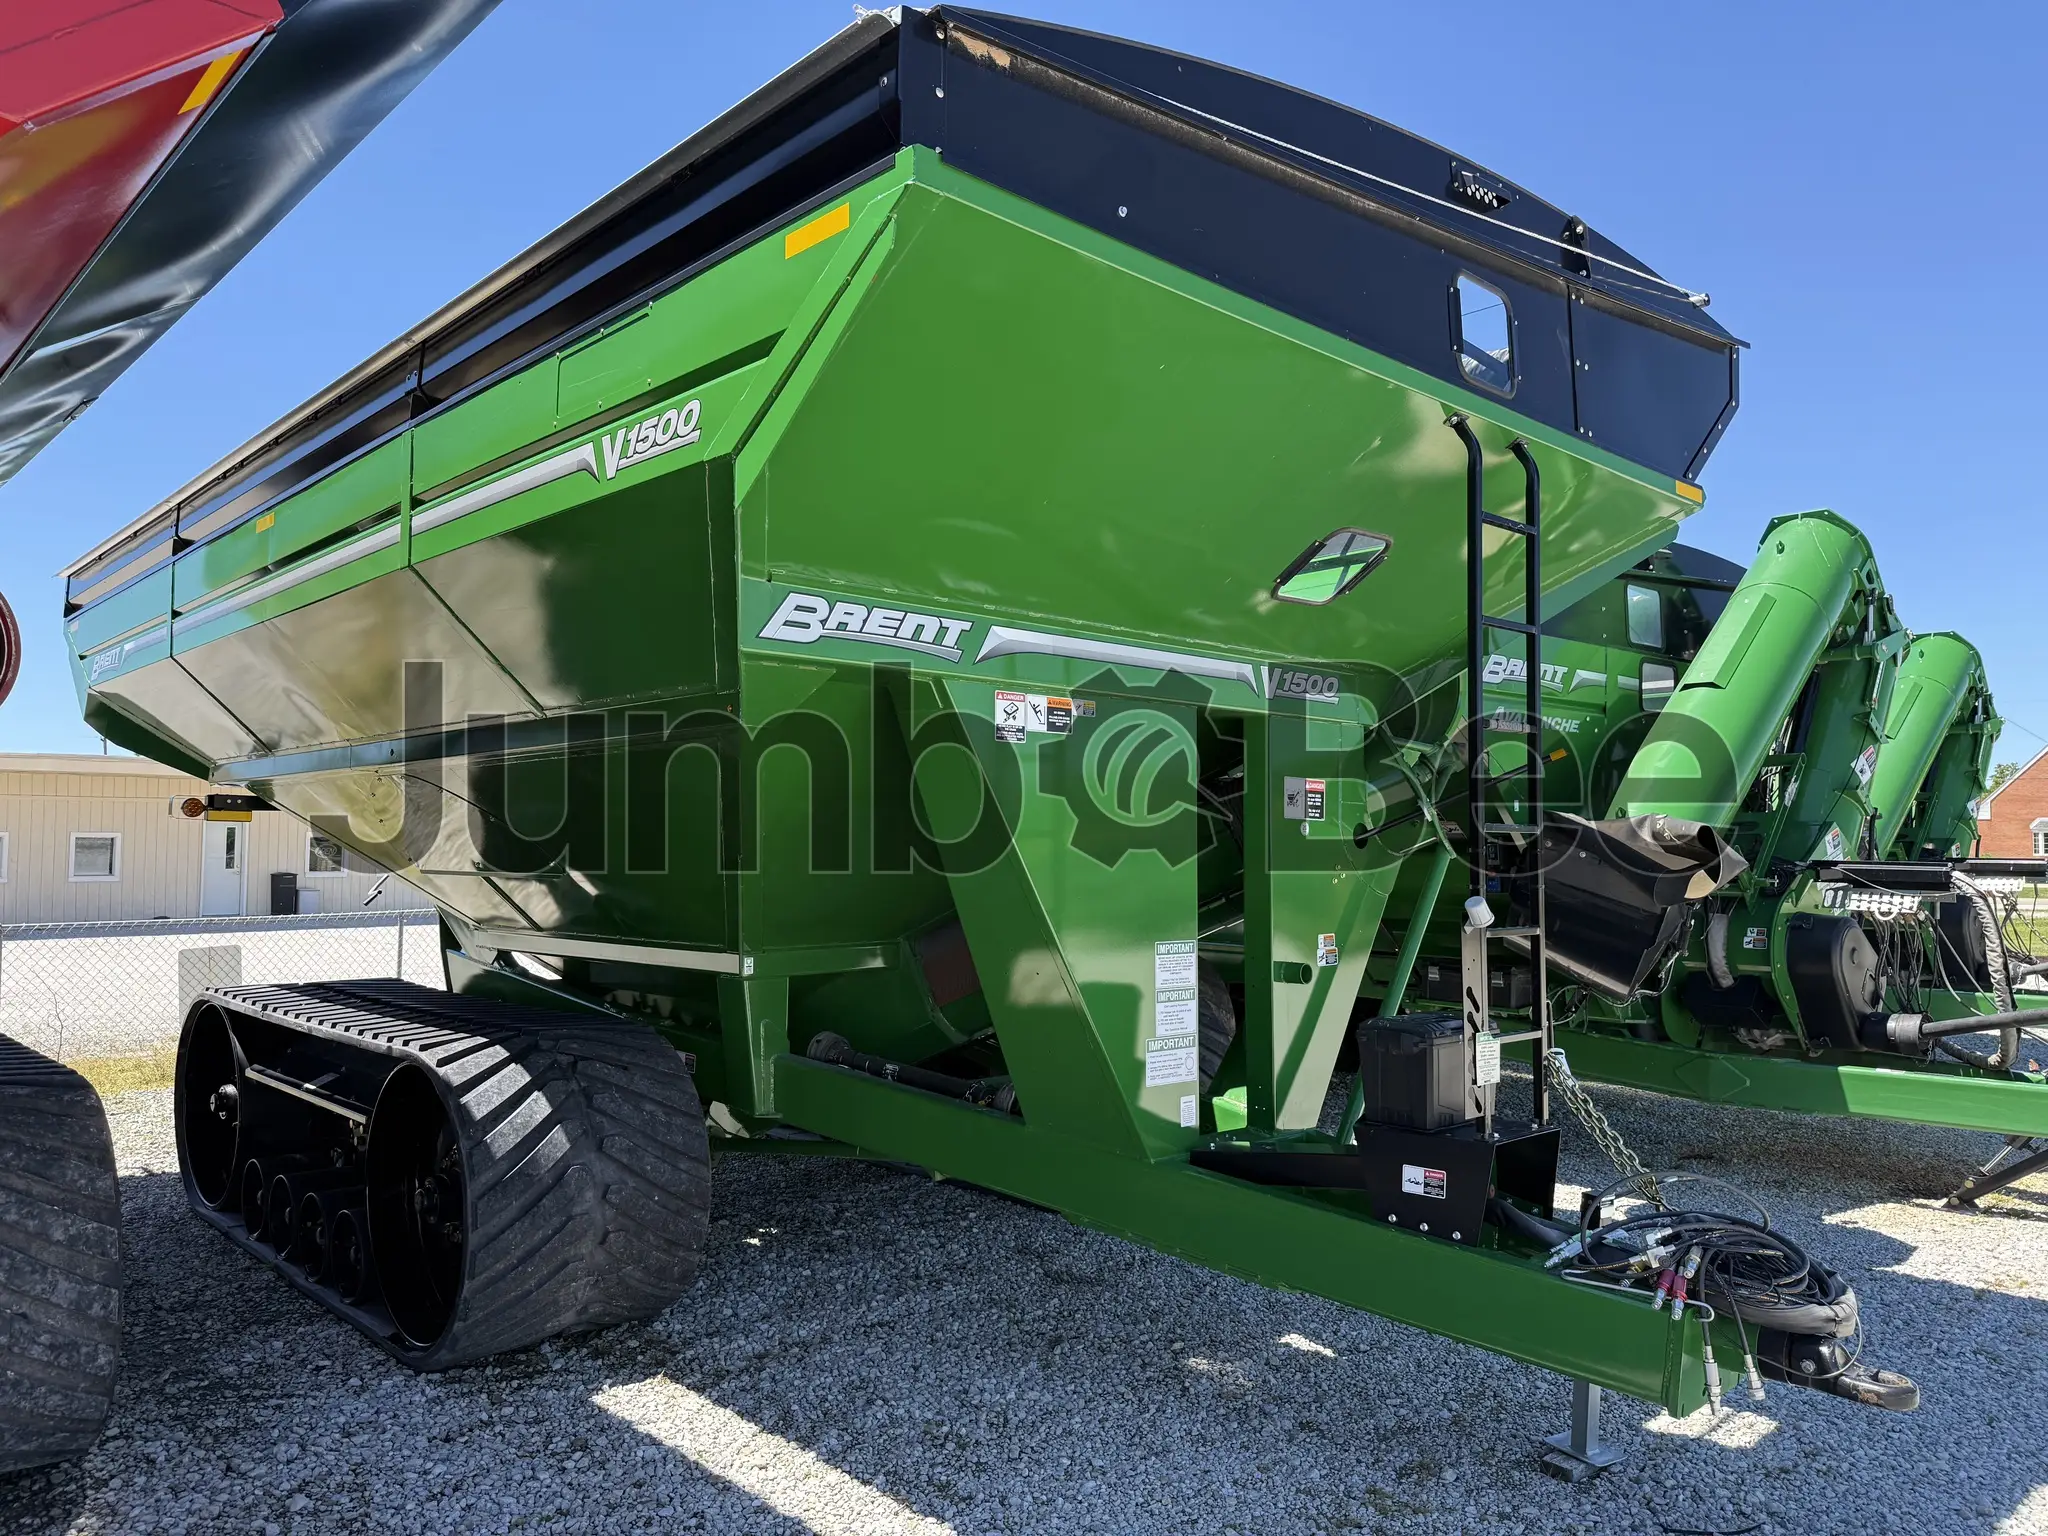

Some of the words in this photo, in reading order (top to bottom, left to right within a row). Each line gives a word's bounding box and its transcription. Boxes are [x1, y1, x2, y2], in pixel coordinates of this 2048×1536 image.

[601, 399, 702, 481] V1500
[757, 591, 974, 650] BRENT
[1483, 654, 1568, 684] BRNT
[1260, 665, 1339, 699] V1500
[1003, 693, 1025, 701] DANGER
[1157, 943, 1194, 954] IMPORTANT
[1158, 989, 1195, 1002] IMPORTANT
[1148, 1036, 1194, 1051] IMPORTANT
